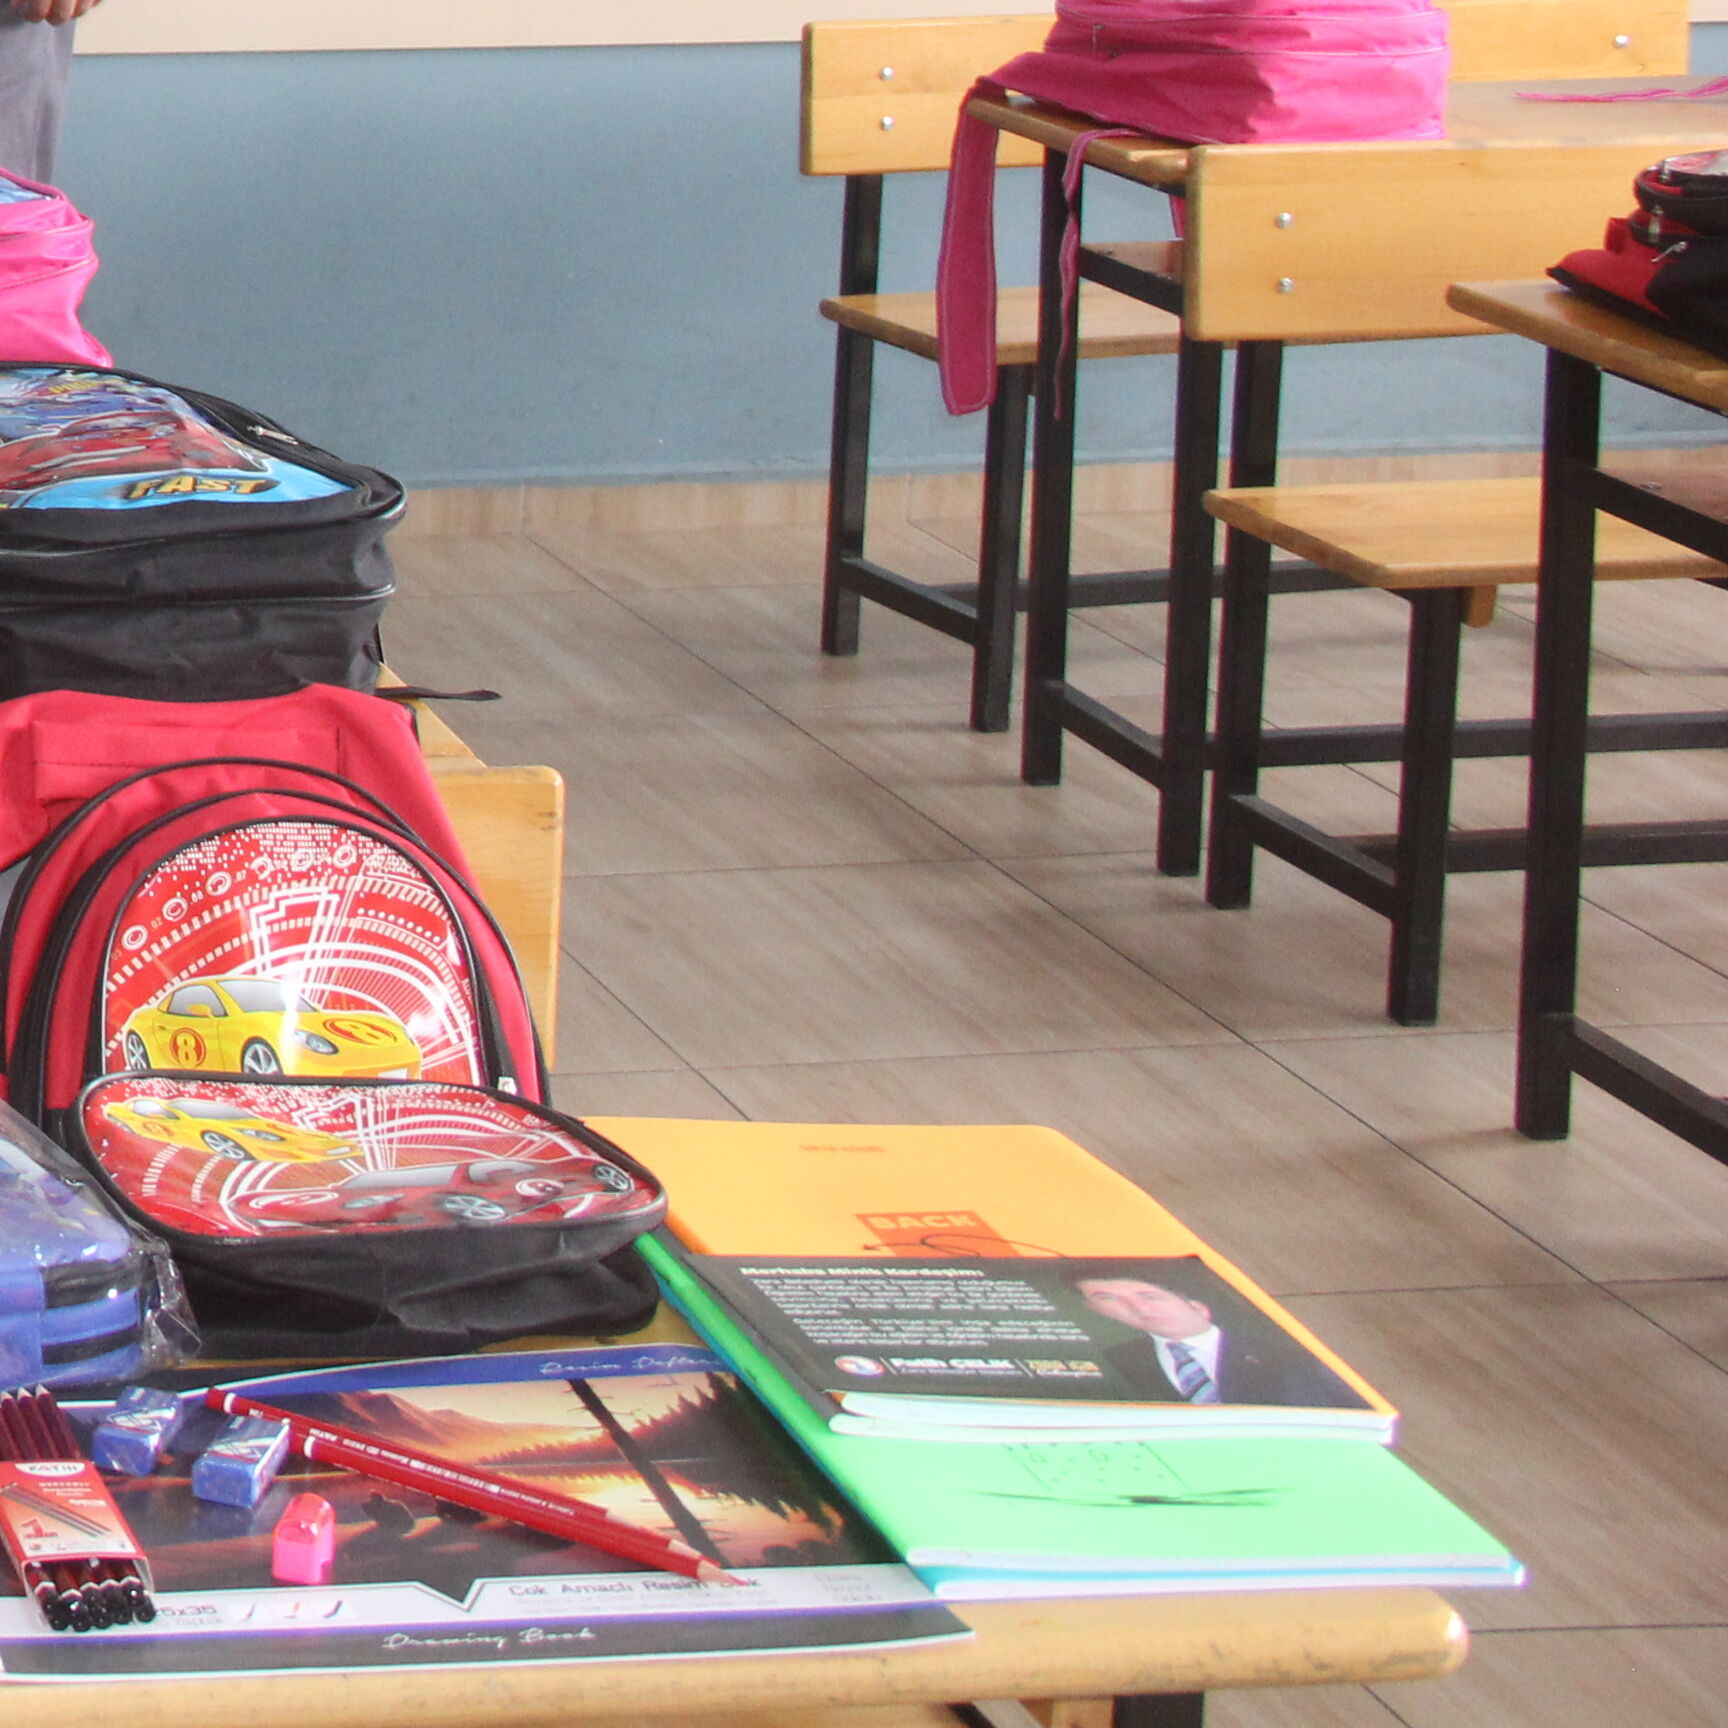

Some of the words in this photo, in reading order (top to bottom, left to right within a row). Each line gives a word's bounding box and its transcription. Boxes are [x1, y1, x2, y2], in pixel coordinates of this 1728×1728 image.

[128, 475, 270, 500] FAST
[867, 1214, 977, 1229] BACK
[155, 1602, 218, 1617] 5x35
[382, 1631, 508, 1651] Drawing
[518, 1626, 597, 1646] Book
